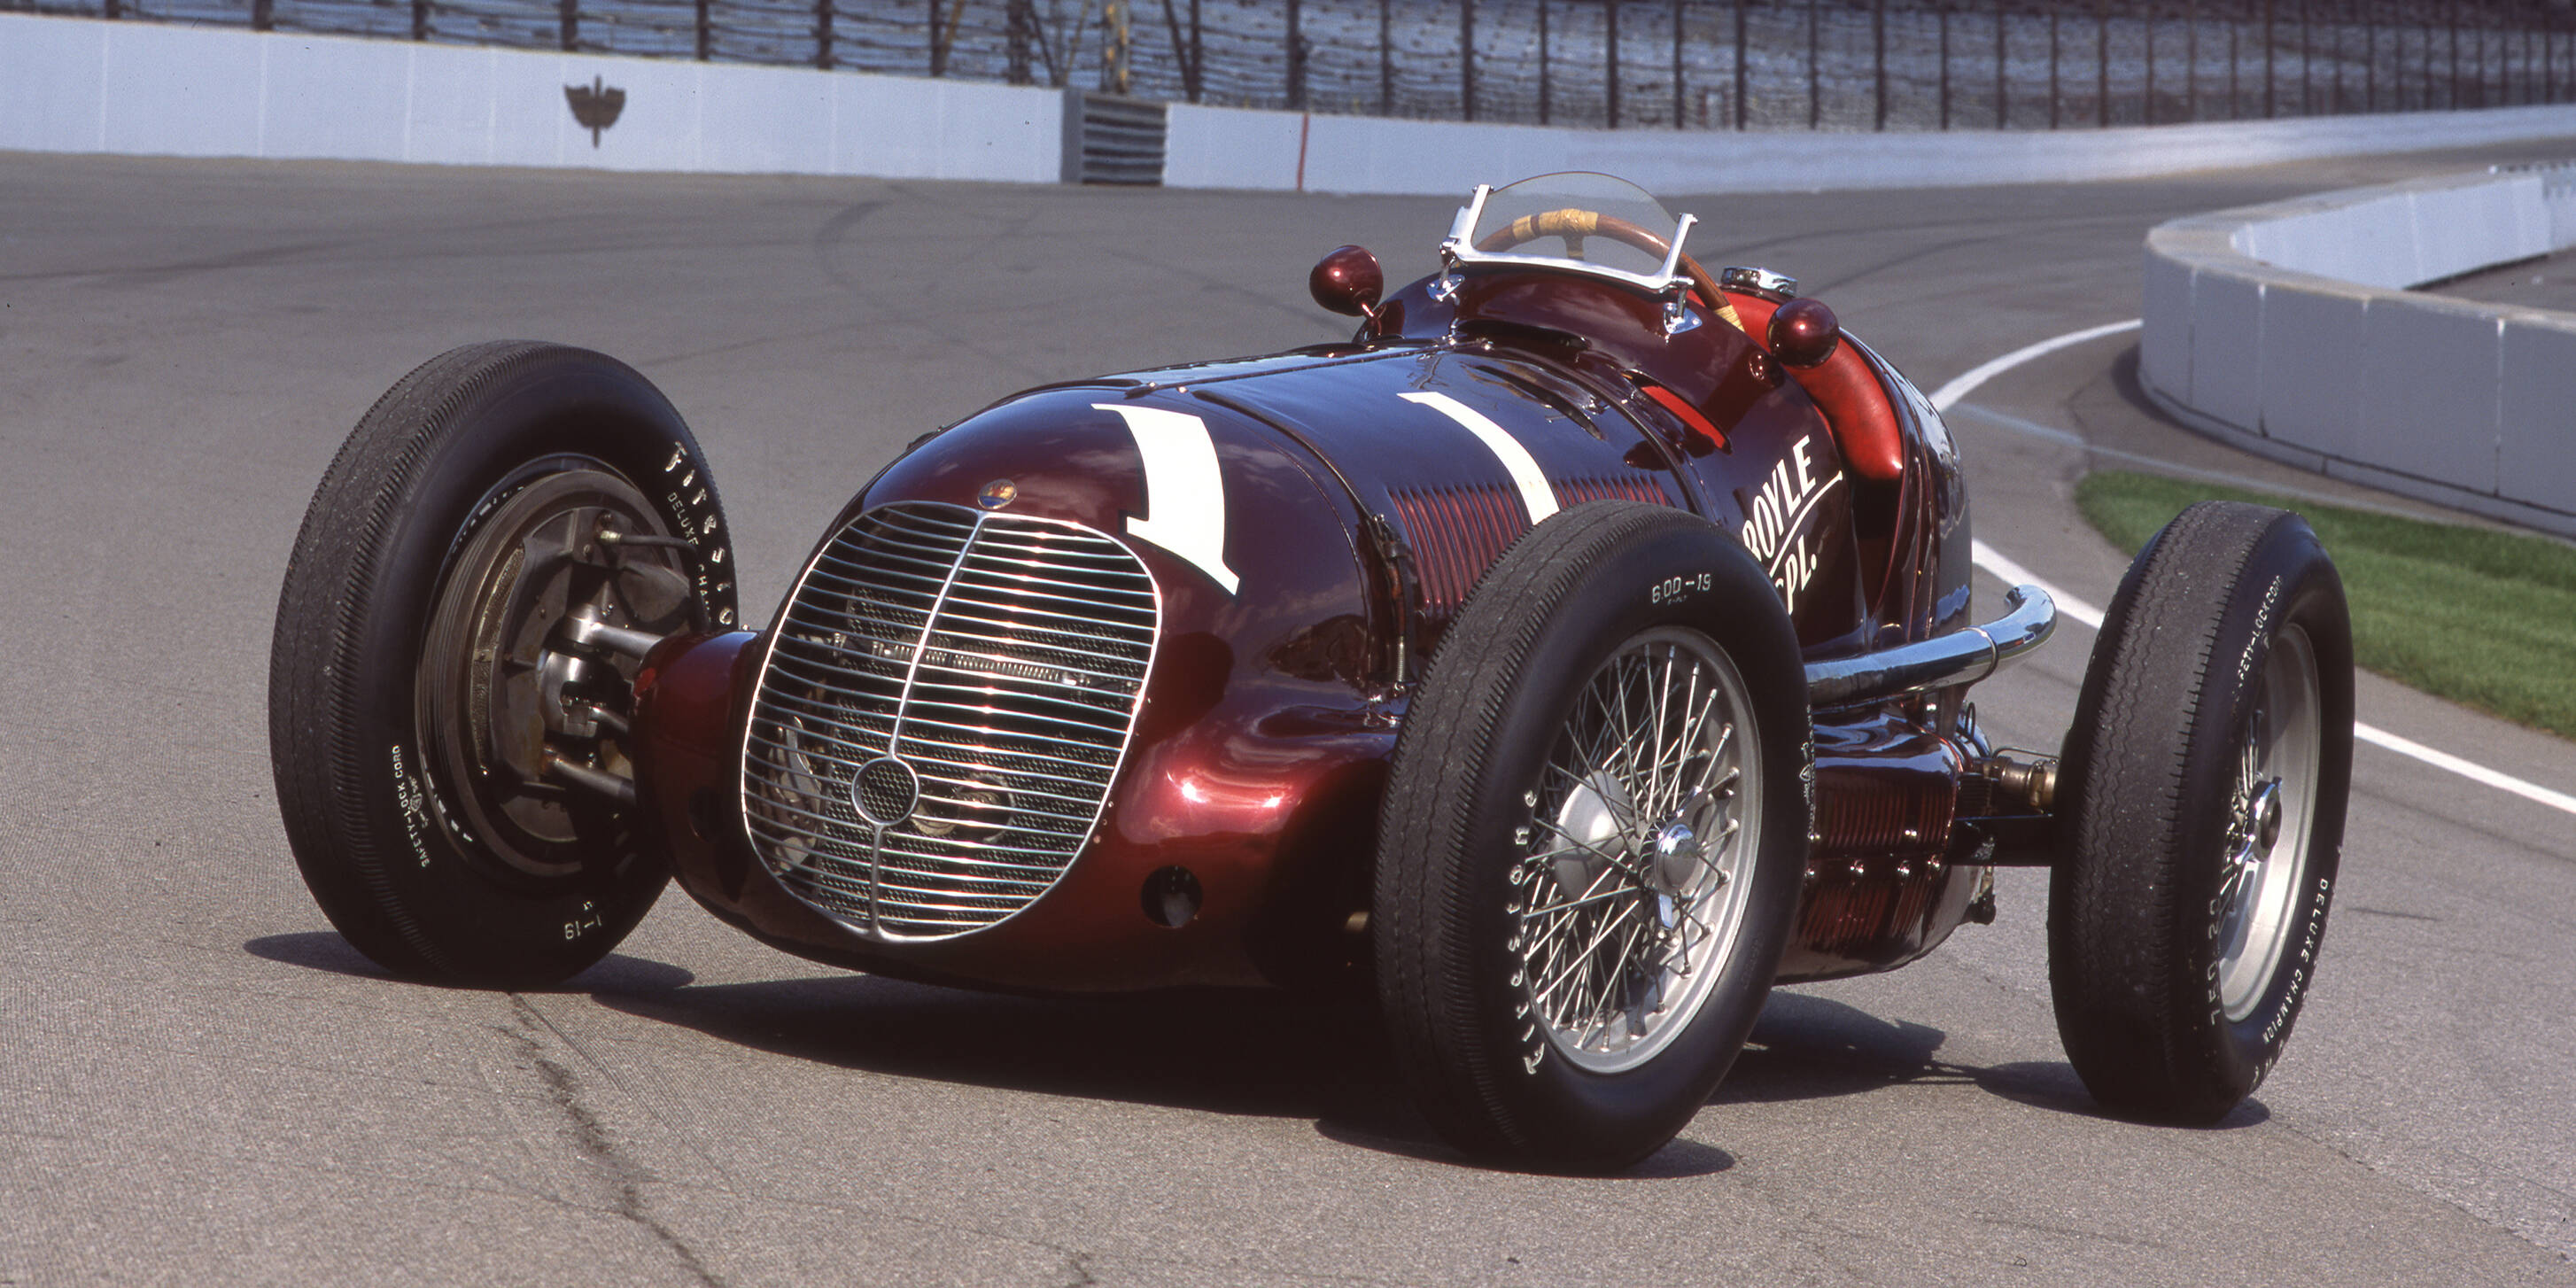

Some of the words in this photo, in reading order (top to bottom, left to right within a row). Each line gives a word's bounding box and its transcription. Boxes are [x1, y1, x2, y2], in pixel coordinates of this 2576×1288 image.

[667, 491, 699, 547] DELUXE
[1091, 403, 1240, 595] 1
[1742, 434, 1816, 563] BOYLE
[1774, 534, 1817, 616] PL.
[392, 744, 404, 779] CORD
[1506, 790, 1545, 1075] Firestone
[2301, 878, 2329, 963] DELUXE
[2262, 968, 2304, 1044] CHAMPION
